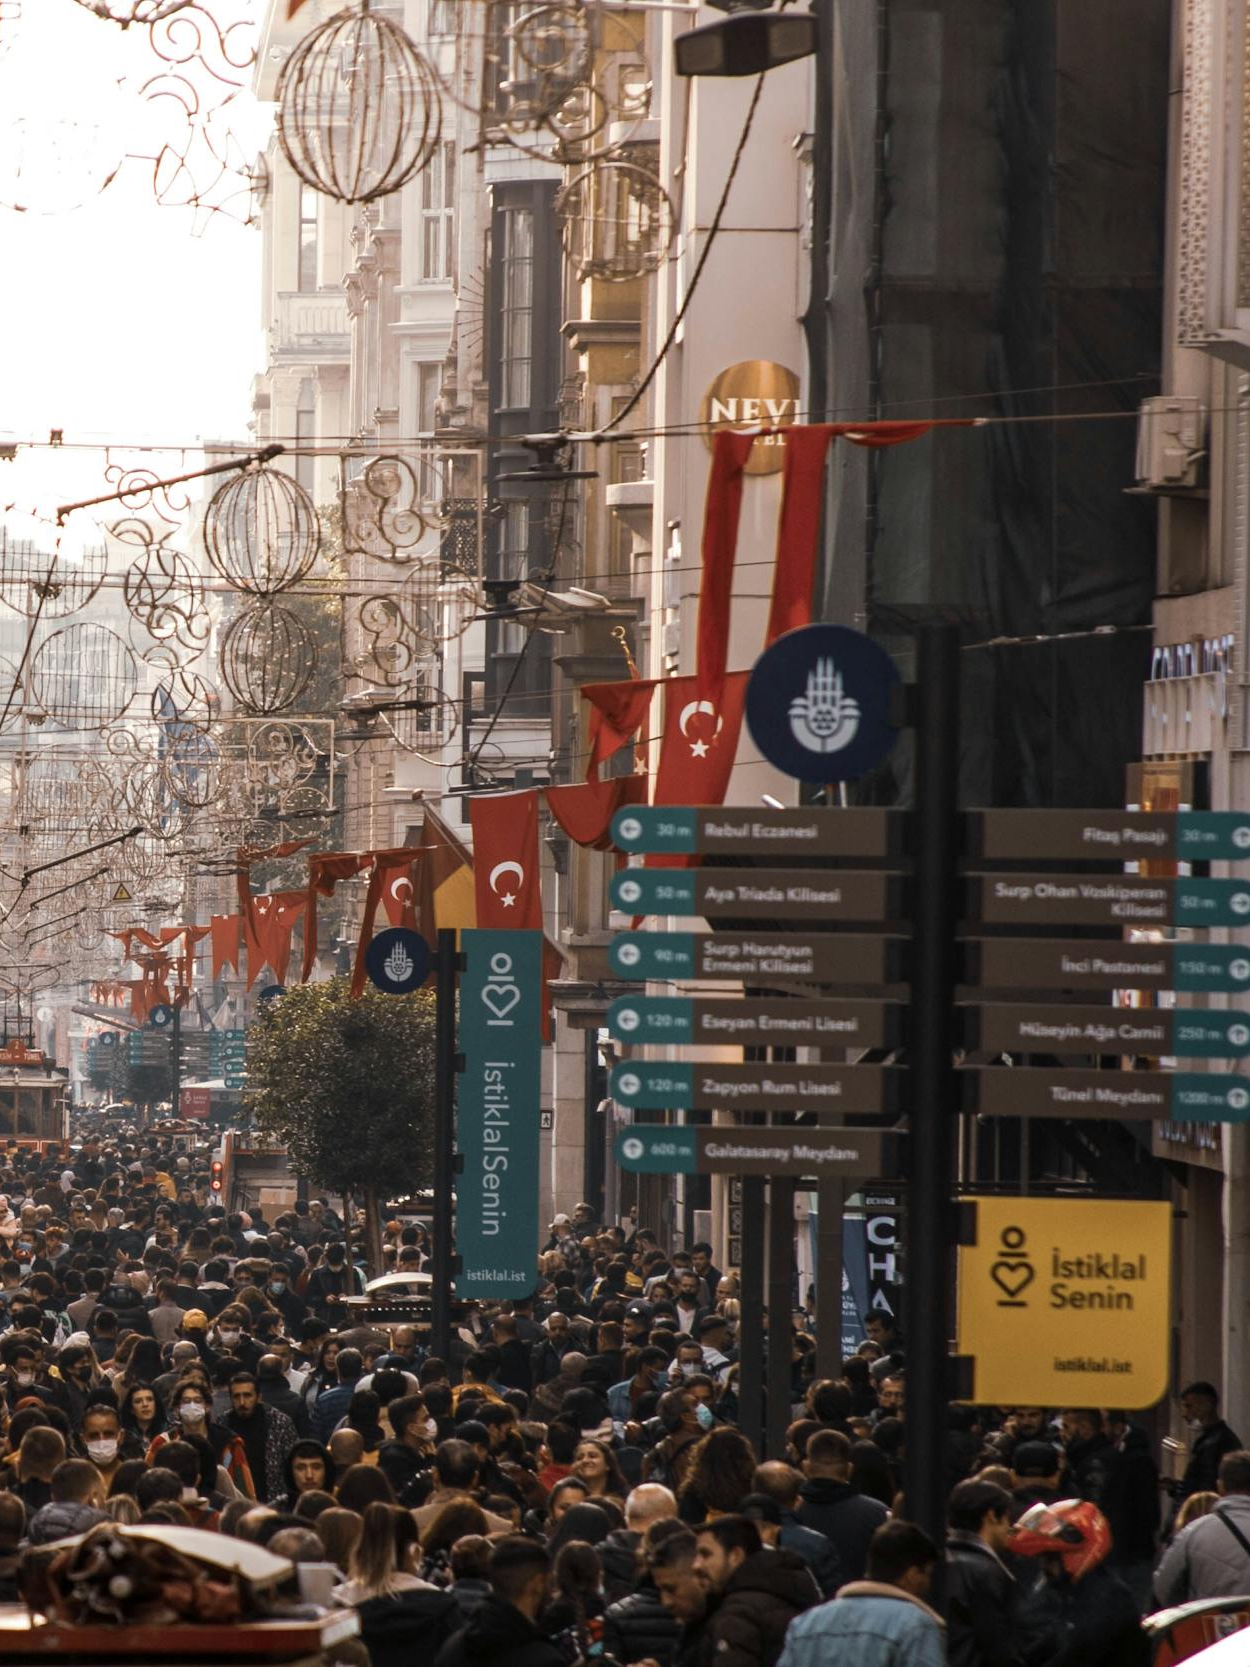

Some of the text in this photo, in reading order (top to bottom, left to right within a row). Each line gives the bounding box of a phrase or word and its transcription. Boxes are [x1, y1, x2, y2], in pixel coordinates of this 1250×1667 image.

[677, 827, 692, 837] m
[705, 823, 747, 838] Rebul
[752, 824, 818, 839] Eczanesi
[675, 889, 690, 899] m
[705, 886, 735, 904] Aya
[737, 887, 784, 902] Triada
[787, 887, 842, 903] Kilisesi
[995, 882, 1033, 901] Surp
[1034, 883, 1078, 899] Ohan
[674, 953, 689, 962] m
[703, 941, 740, 958] Surp
[702, 958, 814, 974] Ermeni Kilisesi
[1092, 958, 1166, 975] Pastanesi
[674, 1017, 688, 1027] m
[758, 1015, 814, 1030] Ermeni
[815, 1016, 859, 1032] Lisesi
[674, 1082, 688, 1092] m
[702, 1078, 760, 1097] Zapyon
[762, 1080, 797, 1094] Rum
[799, 1081, 843, 1096] Lisesi
[1050, 1086, 1091, 1102] Tünel
[705, 1143, 789, 1162] Galatasaray
[1051, 1247, 1147, 1281] İstiklal
[466, 1268, 526, 1283] istiklal.ist
[1049, 1283, 1135, 1311] Senin
[1054, 1356, 1133, 1374] istiklal.ist
